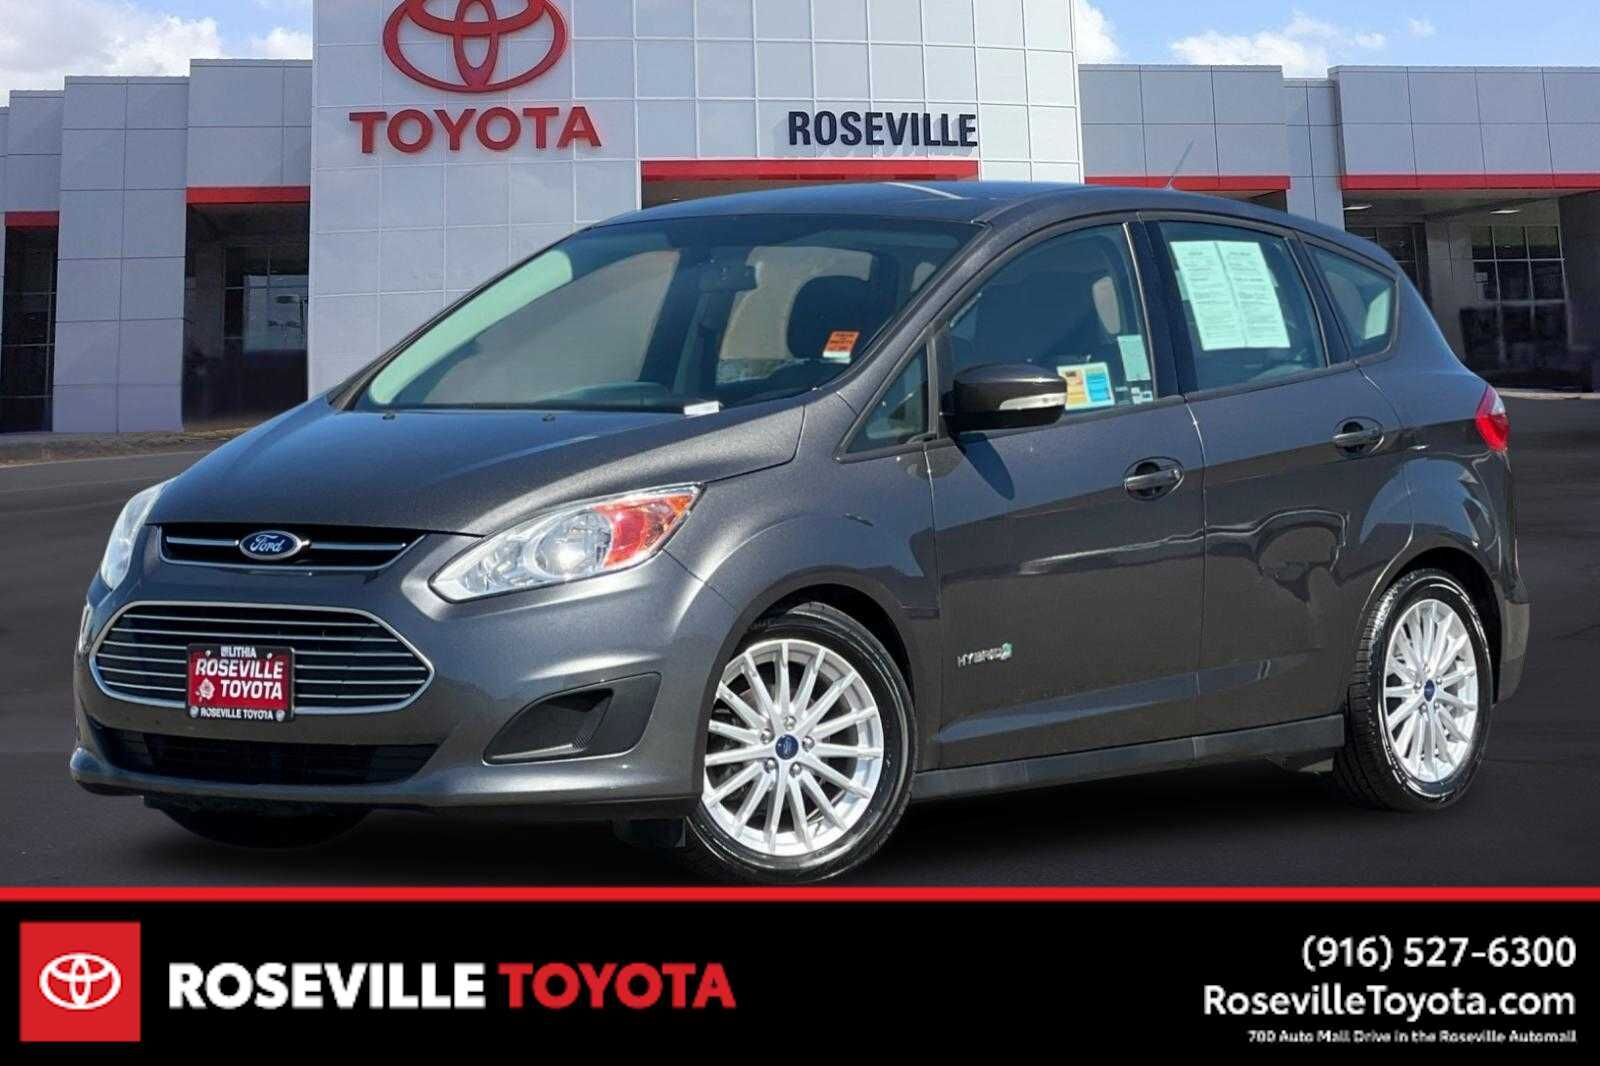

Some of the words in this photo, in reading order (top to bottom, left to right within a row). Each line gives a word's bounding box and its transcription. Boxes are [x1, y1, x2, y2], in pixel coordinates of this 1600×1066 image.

[349, 106, 602, 154] TOYOTA
[788, 110, 978, 147] ROSEVILLE
[250, 534, 285, 552] Ford
[228, 646, 257, 658] LITHIA
[195, 658, 284, 679] ROSEVILLE
[220, 680, 283, 700] TOYOTA
[200, 708, 242, 719] ROSEVILLE
[243, 710, 273, 720] TOYOTA
